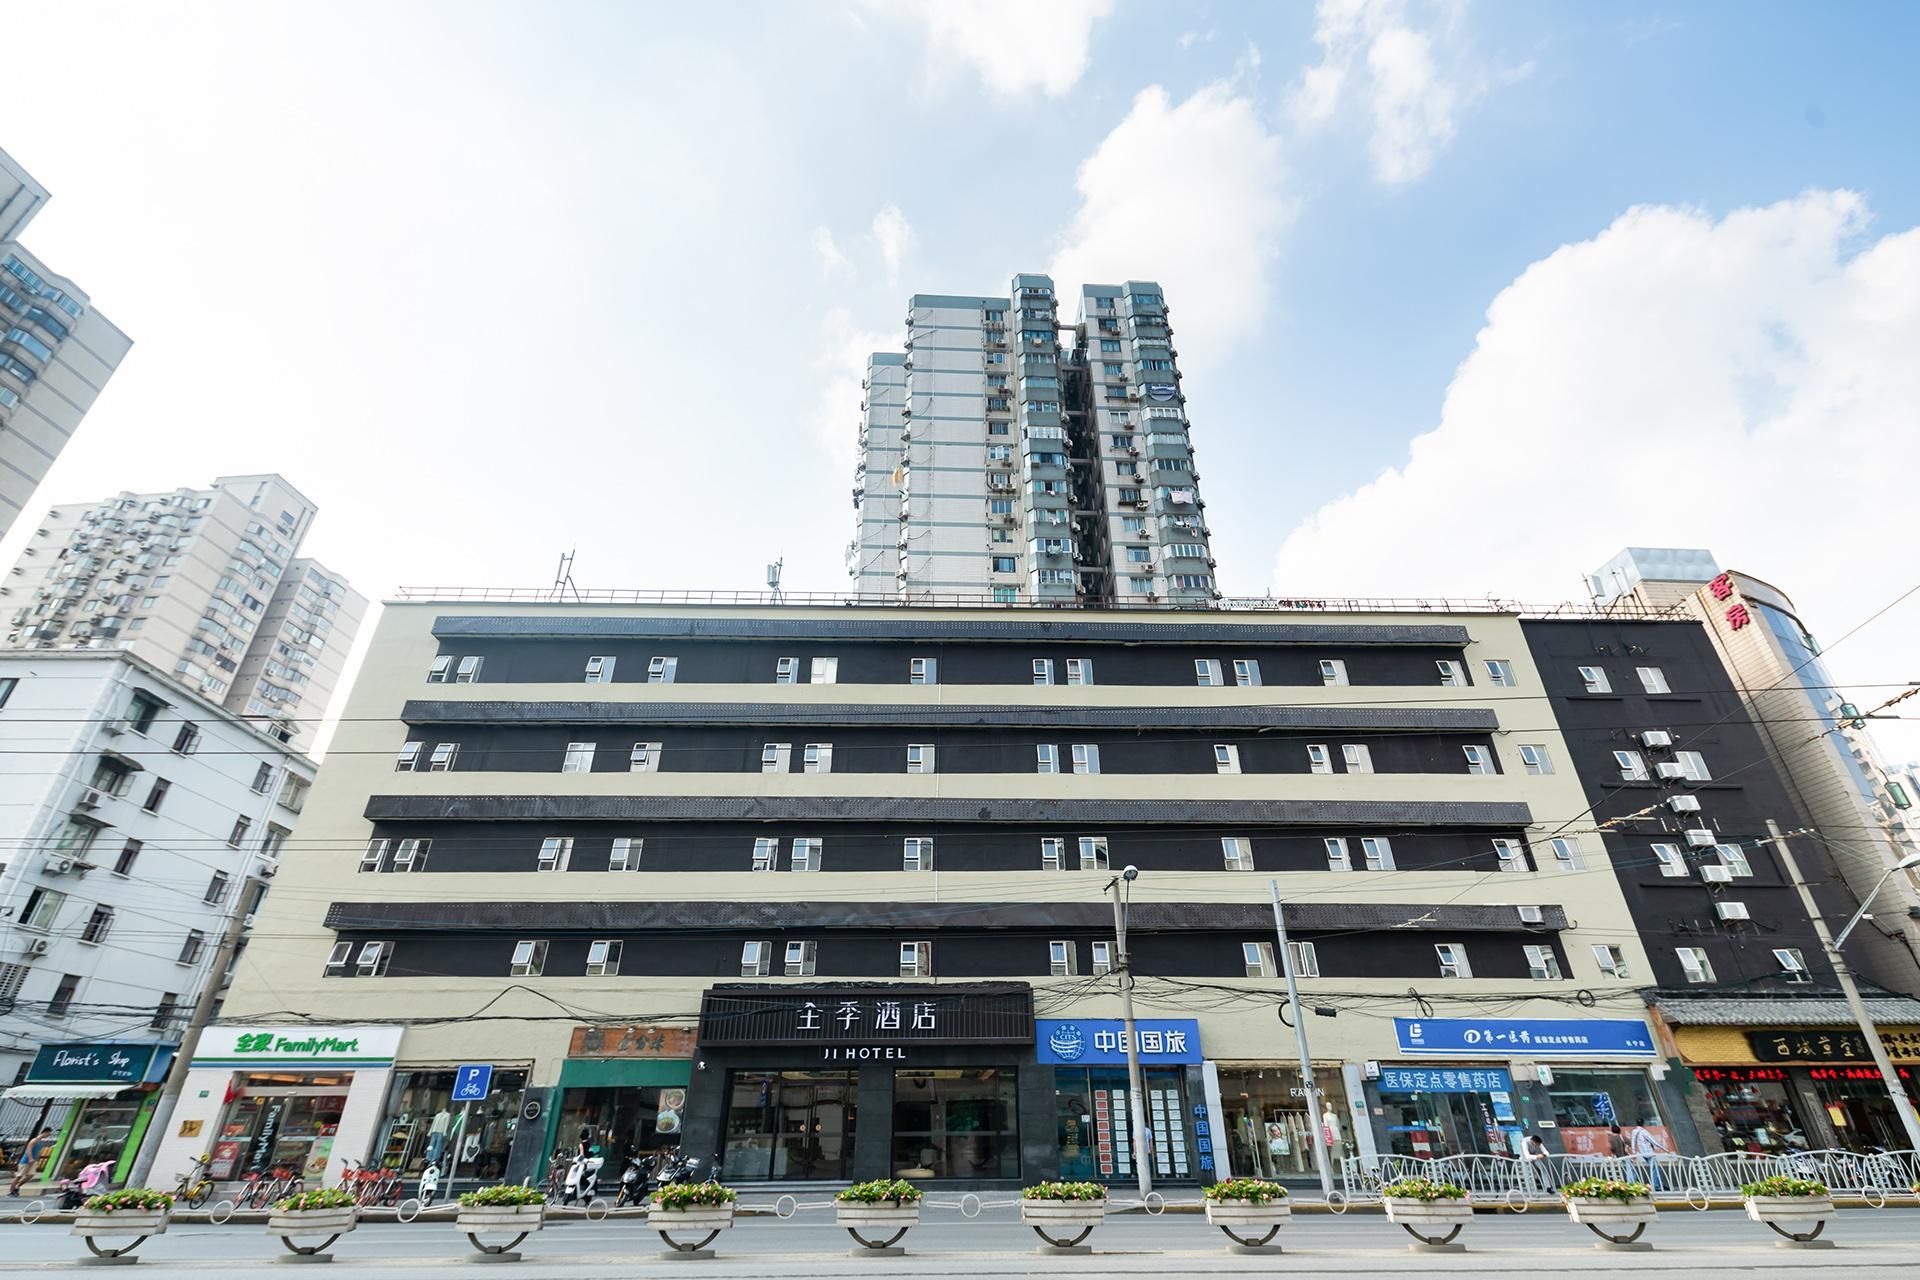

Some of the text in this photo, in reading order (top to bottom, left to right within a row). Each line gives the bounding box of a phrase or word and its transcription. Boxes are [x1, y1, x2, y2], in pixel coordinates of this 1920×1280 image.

[1709, 573, 1750, 631] 客房
[796, 1001, 937, 1030] 全季酒店
[234, 1033, 358, 1056] 全家 FamilyMart
[1094, 1030, 1187, 1053] 中国国旅
[52, 1050, 130, 1068] Florist's Shop
[824, 1048, 906, 1059] JI HOTEL
[468, 1069, 480, 1081] P
[1384, 1071, 1501, 1089] 医保定点零售药店
[249, 1104, 283, 1171] FamilyMart
[1193, 1104, 1214, 1171] 中国国旅
